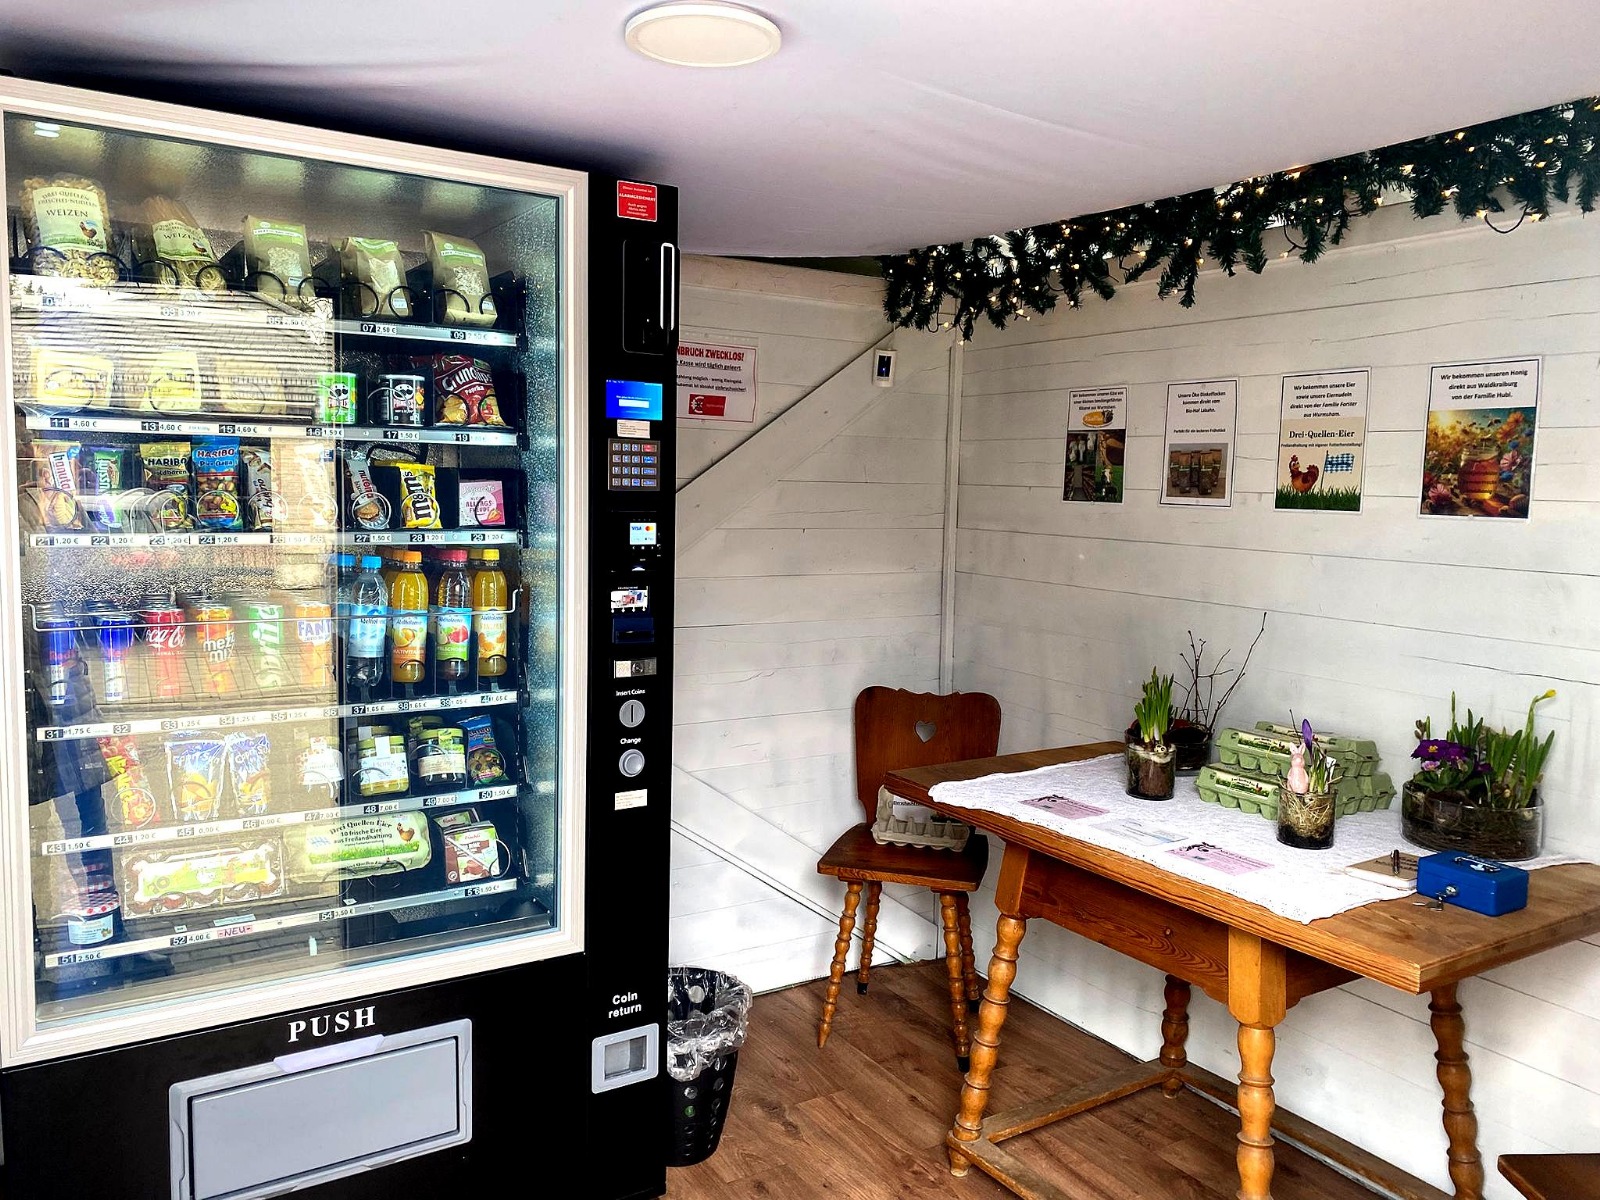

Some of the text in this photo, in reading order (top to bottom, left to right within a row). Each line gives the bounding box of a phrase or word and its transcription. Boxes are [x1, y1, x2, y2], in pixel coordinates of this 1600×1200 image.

[46, 208, 89, 218] WEIZEN
[362, 324, 374, 332] 07
[453, 331, 464, 340] 09
[705, 348, 745, 362] ZWECKLOS!
[707, 362, 724, 370] täglich
[1510, 369, 1528, 377] Honig
[442, 367, 493, 391] Crunchips
[1478, 381, 1518, 390] Waldkraiburg
[1326, 391, 1352, 399] Eiernudeln
[1474, 392, 1496, 400] Familie
[51, 418, 67, 428] 11
[73, 420, 90, 428] 4,60
[143, 422, 176, 431] 13 4,60
[220, 424, 235, 434] 15
[236, 425, 252, 434] 4,60
[307, 428, 321, 436] 16
[386, 431, 398, 439] 17
[457, 433, 468, 442] 19
[197, 448, 235, 458] HARIBO
[148, 457, 187, 467] HARIBO
[52, 453, 73, 491] hanuta
[37, 536, 51, 546] 21
[92, 535, 128, 545] 22 1,20
[200, 536, 232, 545] 24 1,20
[356, 534, 367, 542] 27
[411, 534, 423, 542] 28
[472, 534, 484, 542] 29
[203, 631, 236, 652] mezz
[252, 604, 282, 690] Sprite
[209, 646, 234, 663] mix
[615, 688, 646, 697] Insert Coins
[398, 702, 409, 710] 38
[114, 724, 129, 734] 32
[163, 720, 177, 729] 33
[46, 730, 59, 740] 31
[67, 728, 84, 736] 1,75
[619, 737, 642, 745] Change
[425, 798, 436, 806] 49
[365, 805, 377, 813] 48
[244, 820, 257, 830] 46
[347, 819, 375, 829] Quellen
[376, 819, 393, 829] Eier
[349, 828, 370, 836] frische
[345, 833, 393, 844] Freilandhaltung
[68, 841, 84, 850] 1,50
[172, 934, 205, 947] 52 4,00
[60, 953, 95, 965] 51 2,50
[612, 991, 638, 1005] Coin
[608, 1003, 642, 1019] return
[288, 1005, 376, 1043] PUSH
